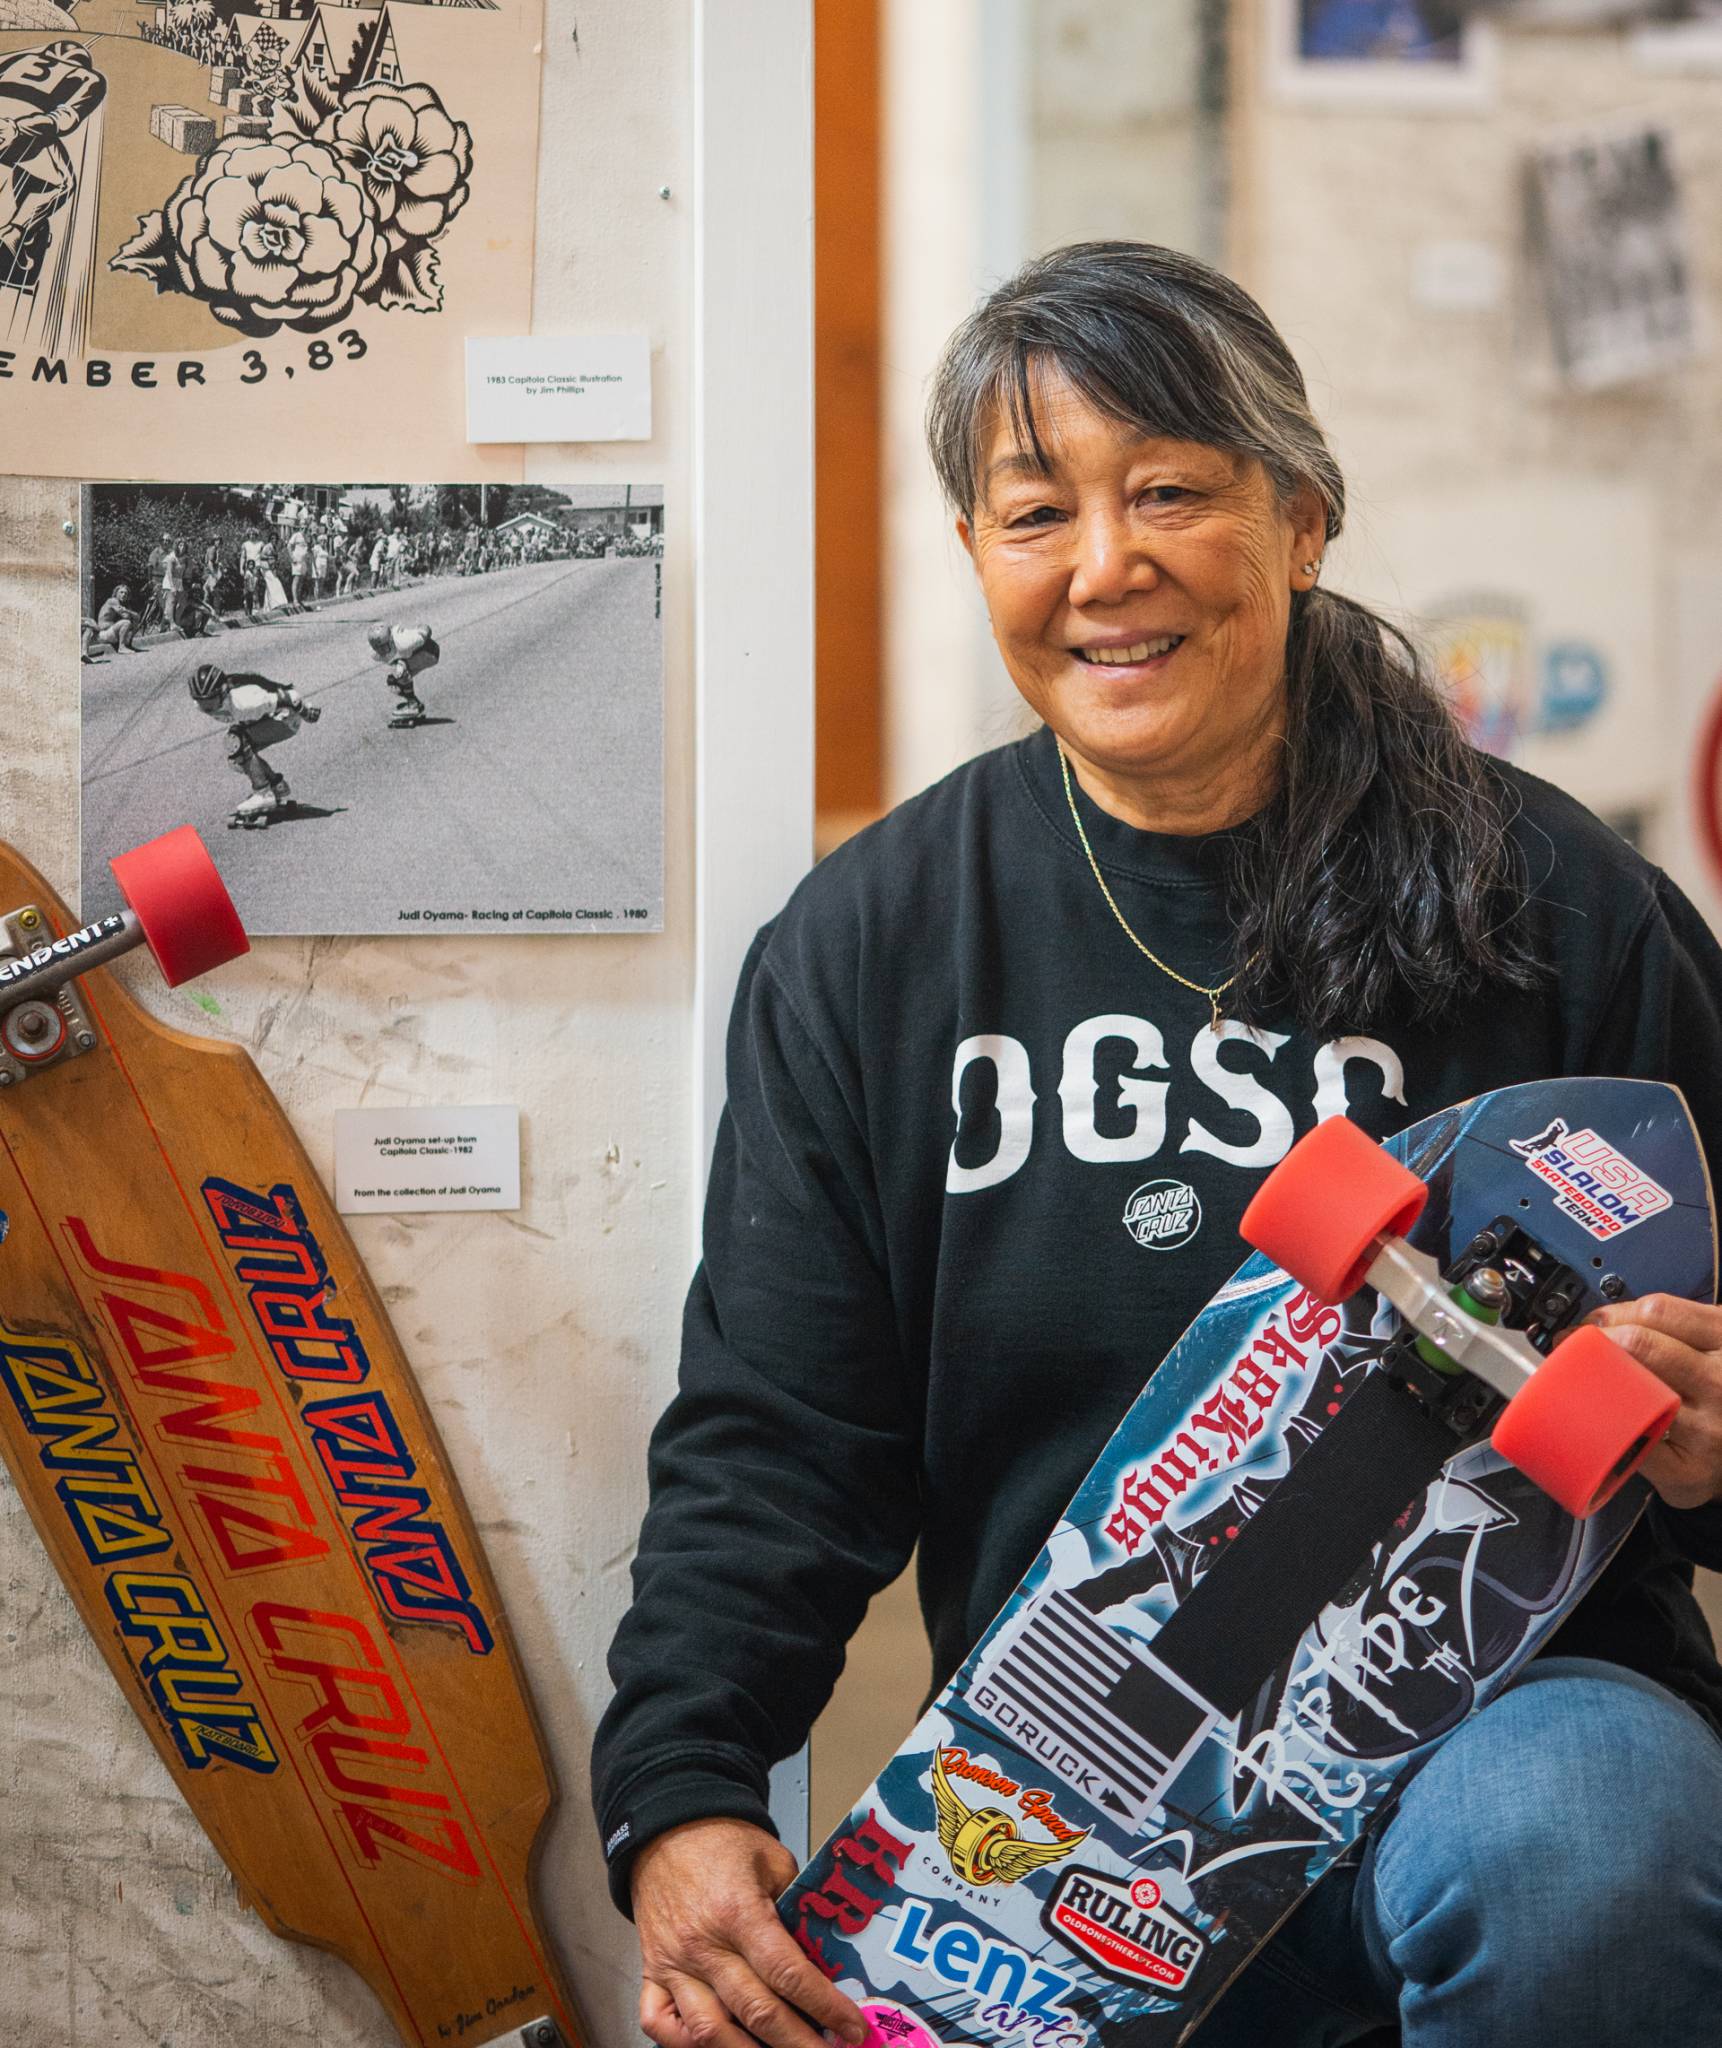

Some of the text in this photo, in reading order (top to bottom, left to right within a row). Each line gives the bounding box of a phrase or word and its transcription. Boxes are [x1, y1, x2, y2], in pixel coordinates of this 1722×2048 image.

[487, 375, 623, 386] 1983 Capitola Classic Illustration
[526, 386, 585, 395] by Jim Phillips
[398, 910, 420, 920] Judi
[472, 910, 509, 922] Racing
[512, 910, 523, 920] at
[526, 910, 573, 922] Capitola
[575, 909, 613, 919] Classic
[624, 909, 648, 919] 1980
[374, 1136, 477, 1147] Judi Oyama set-up from
[380, 1147, 417, 1157] Capitola
[378, 1188, 391, 1197] the
[394, 1187, 436, 1197] collection
[438, 1187, 447, 1195] of
[450, 1186, 466, 1194] Judi
[468, 1186, 501, 1195] Oyama
[1122, 1186, 1193, 1222] SANTA
[1531, 1159, 1622, 1232] SKATEBOARD
[1544, 1150, 1641, 1224] SLALOM
[1561, 1132, 1671, 1215] USA
[1136, 1208, 1193, 1243] CRUZ
[1560, 1197, 1597, 1227] TEAM
[201, 1175, 494, 1656] SANTA CRUZ
[0, 1326, 280, 1774] SANTA CRUZ
[60, 1215, 483, 1887] SANTA CRUZ
[974, 1686, 1101, 1795] GORUCK
[940, 1748, 1087, 1841] Bronson Speed
[923, 1857, 1001, 1907] COMPANY
[1062, 1876, 1200, 1970] RULING
[893, 1905, 1072, 2023] Lenz
